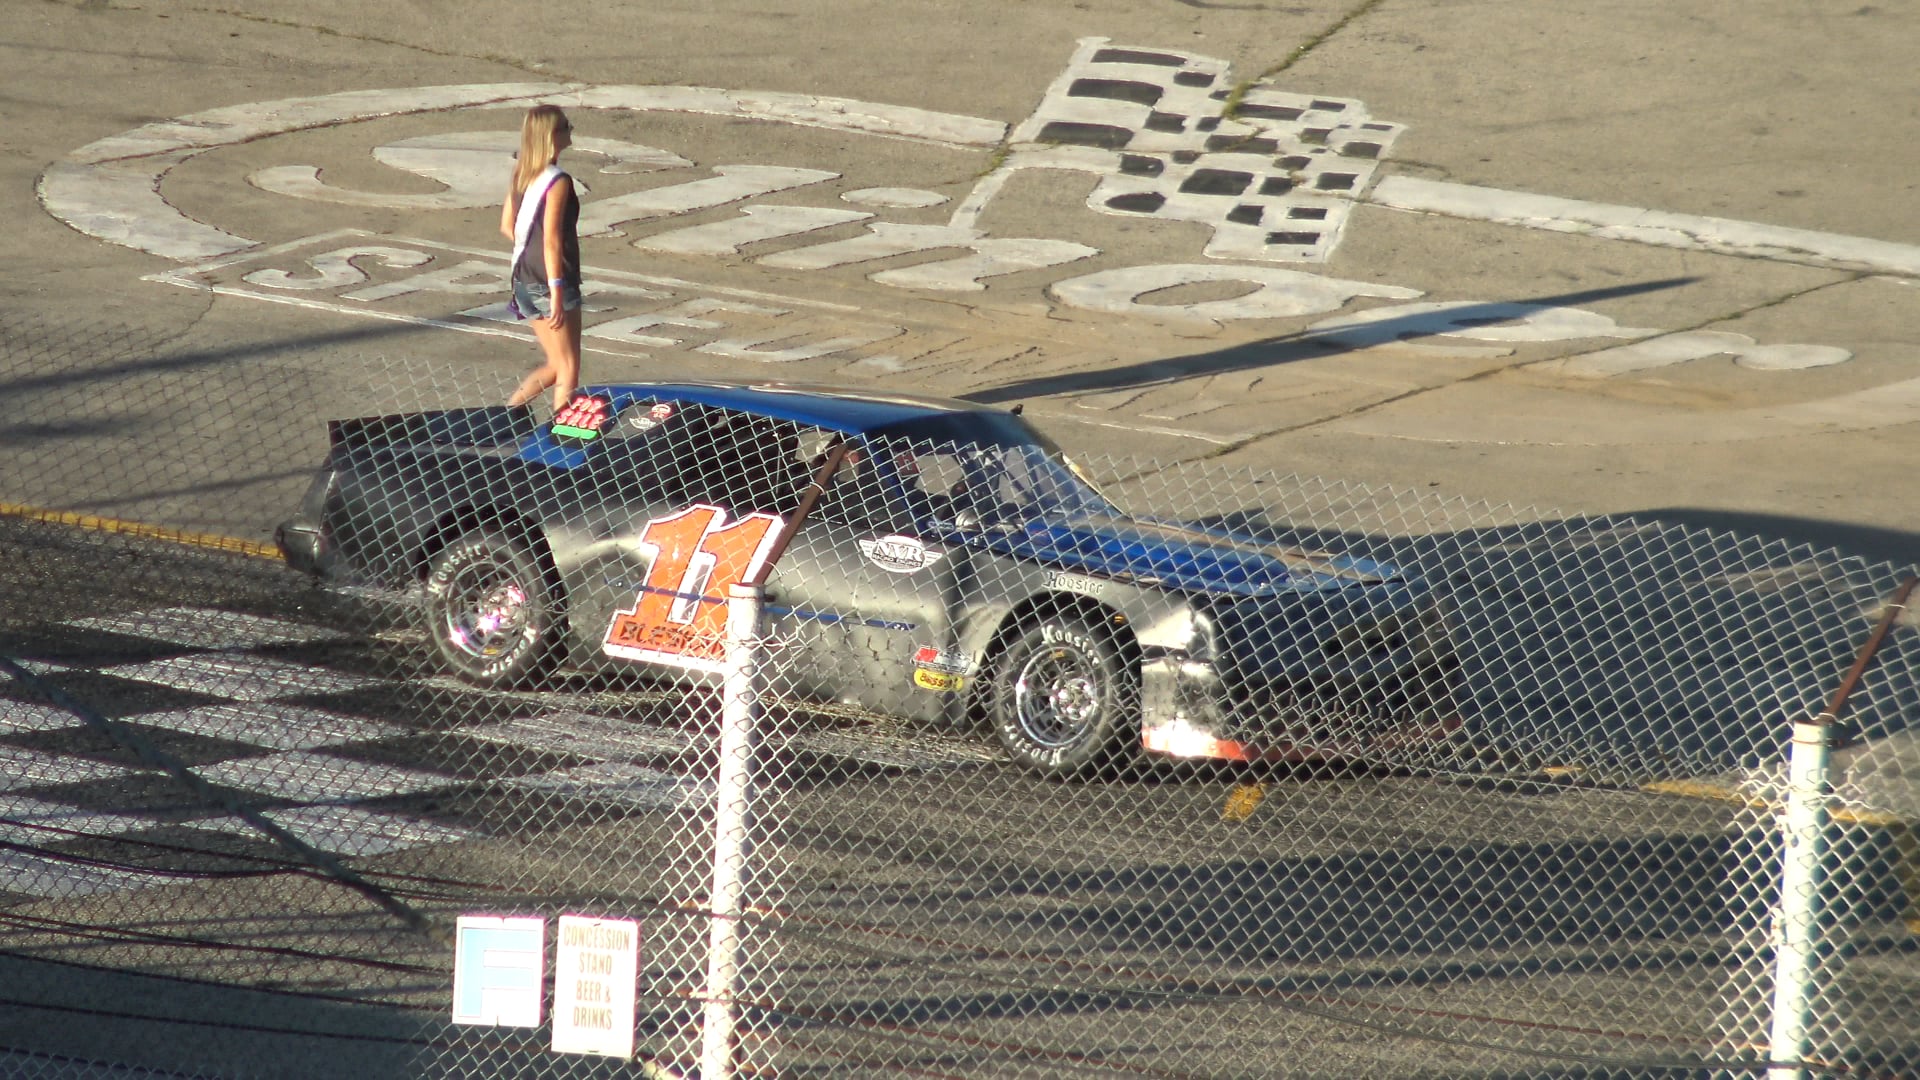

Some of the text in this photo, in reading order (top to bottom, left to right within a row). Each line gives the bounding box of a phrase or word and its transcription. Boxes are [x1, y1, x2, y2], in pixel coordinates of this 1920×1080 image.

[571, 397, 602, 413] FOR
[556, 408, 604, 430] SALE
[603, 504, 784, 672] 11
[1041, 570, 1104, 595] Hoosier
[1041, 624, 1100, 666] Hoosier
[564, 924, 630, 950] CONCESSION
[578, 952, 613, 975] STAND
[576, 980, 612, 1003] BEER &
[573, 1006, 613, 1030] DRINKS
